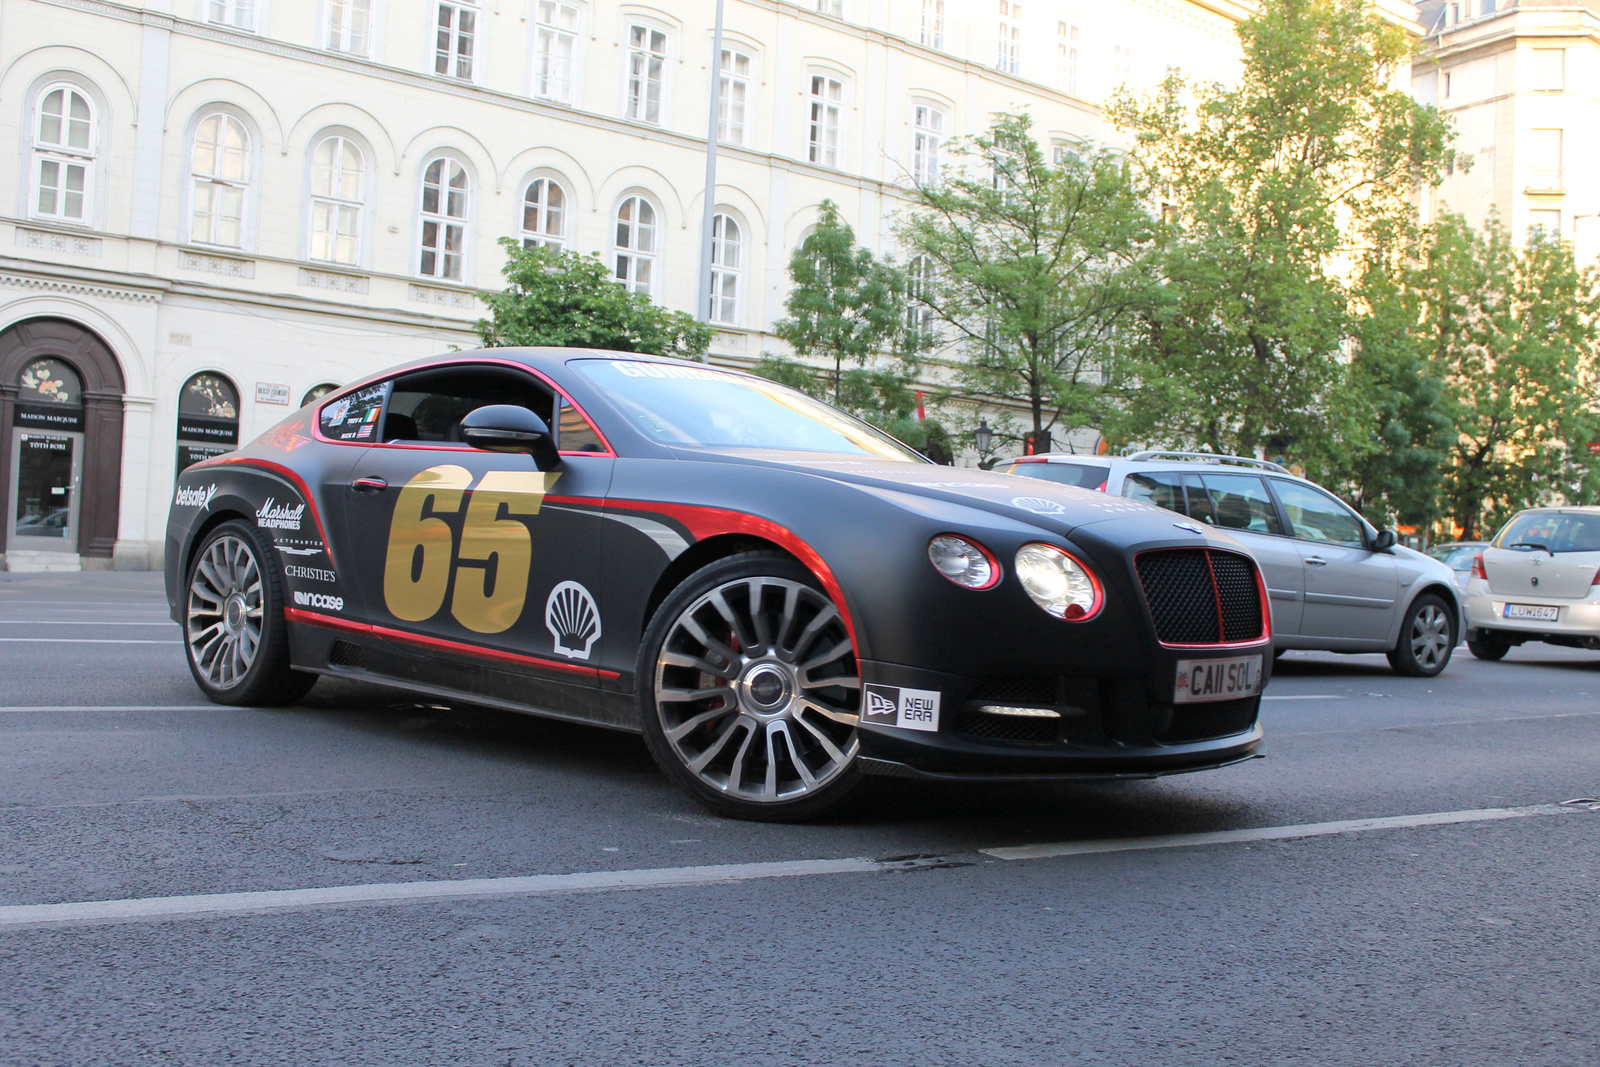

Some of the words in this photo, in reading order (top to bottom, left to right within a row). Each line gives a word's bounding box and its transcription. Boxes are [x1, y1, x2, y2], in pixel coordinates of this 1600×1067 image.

[175, 485, 206, 506] betsafe
[256, 497, 305, 519] Marshall
[257, 518, 301, 530] HEADPHONES
[274, 538, 324, 546] JETSMARTER
[384, 464, 562, 634] 65
[284, 564, 336, 582] CHRISTIE'S
[302, 591, 344, 611] incase
[1226, 661, 1252, 692] SOL
[905, 697, 934, 711] NEW
[904, 708, 932, 722] ERA
